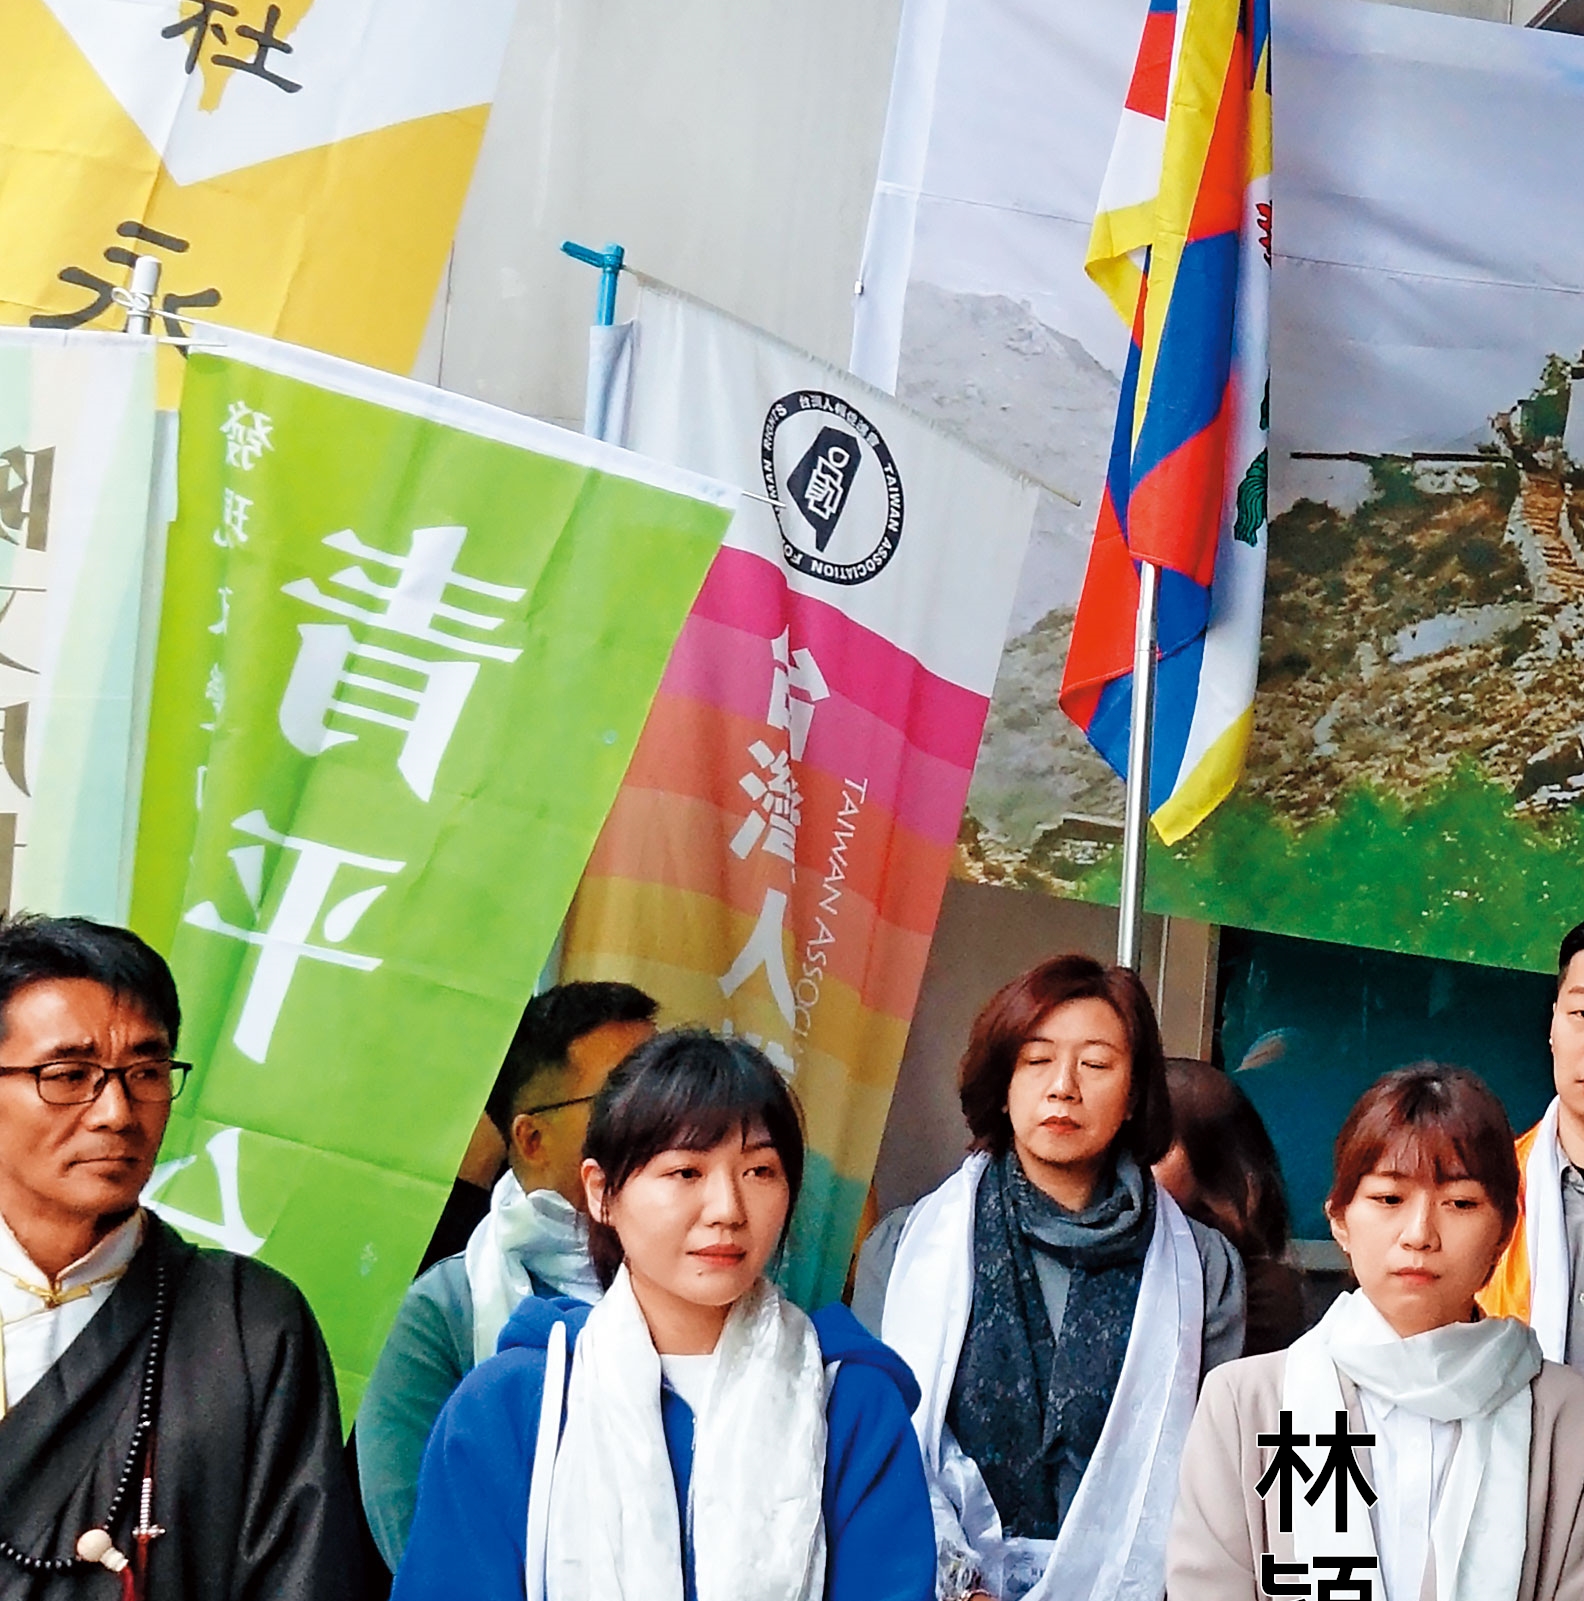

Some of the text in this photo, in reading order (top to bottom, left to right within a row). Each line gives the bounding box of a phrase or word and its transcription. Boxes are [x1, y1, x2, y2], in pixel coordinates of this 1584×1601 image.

[883, 462, 901, 533] TAIWAN
[782, 540, 803, 565] FO
[811, 537, 893, 581] ASSOCIATION
[718, 624, 831, 1082] 台灣人
[793, 777, 869, 1052] TAIWAN ASSOCI
